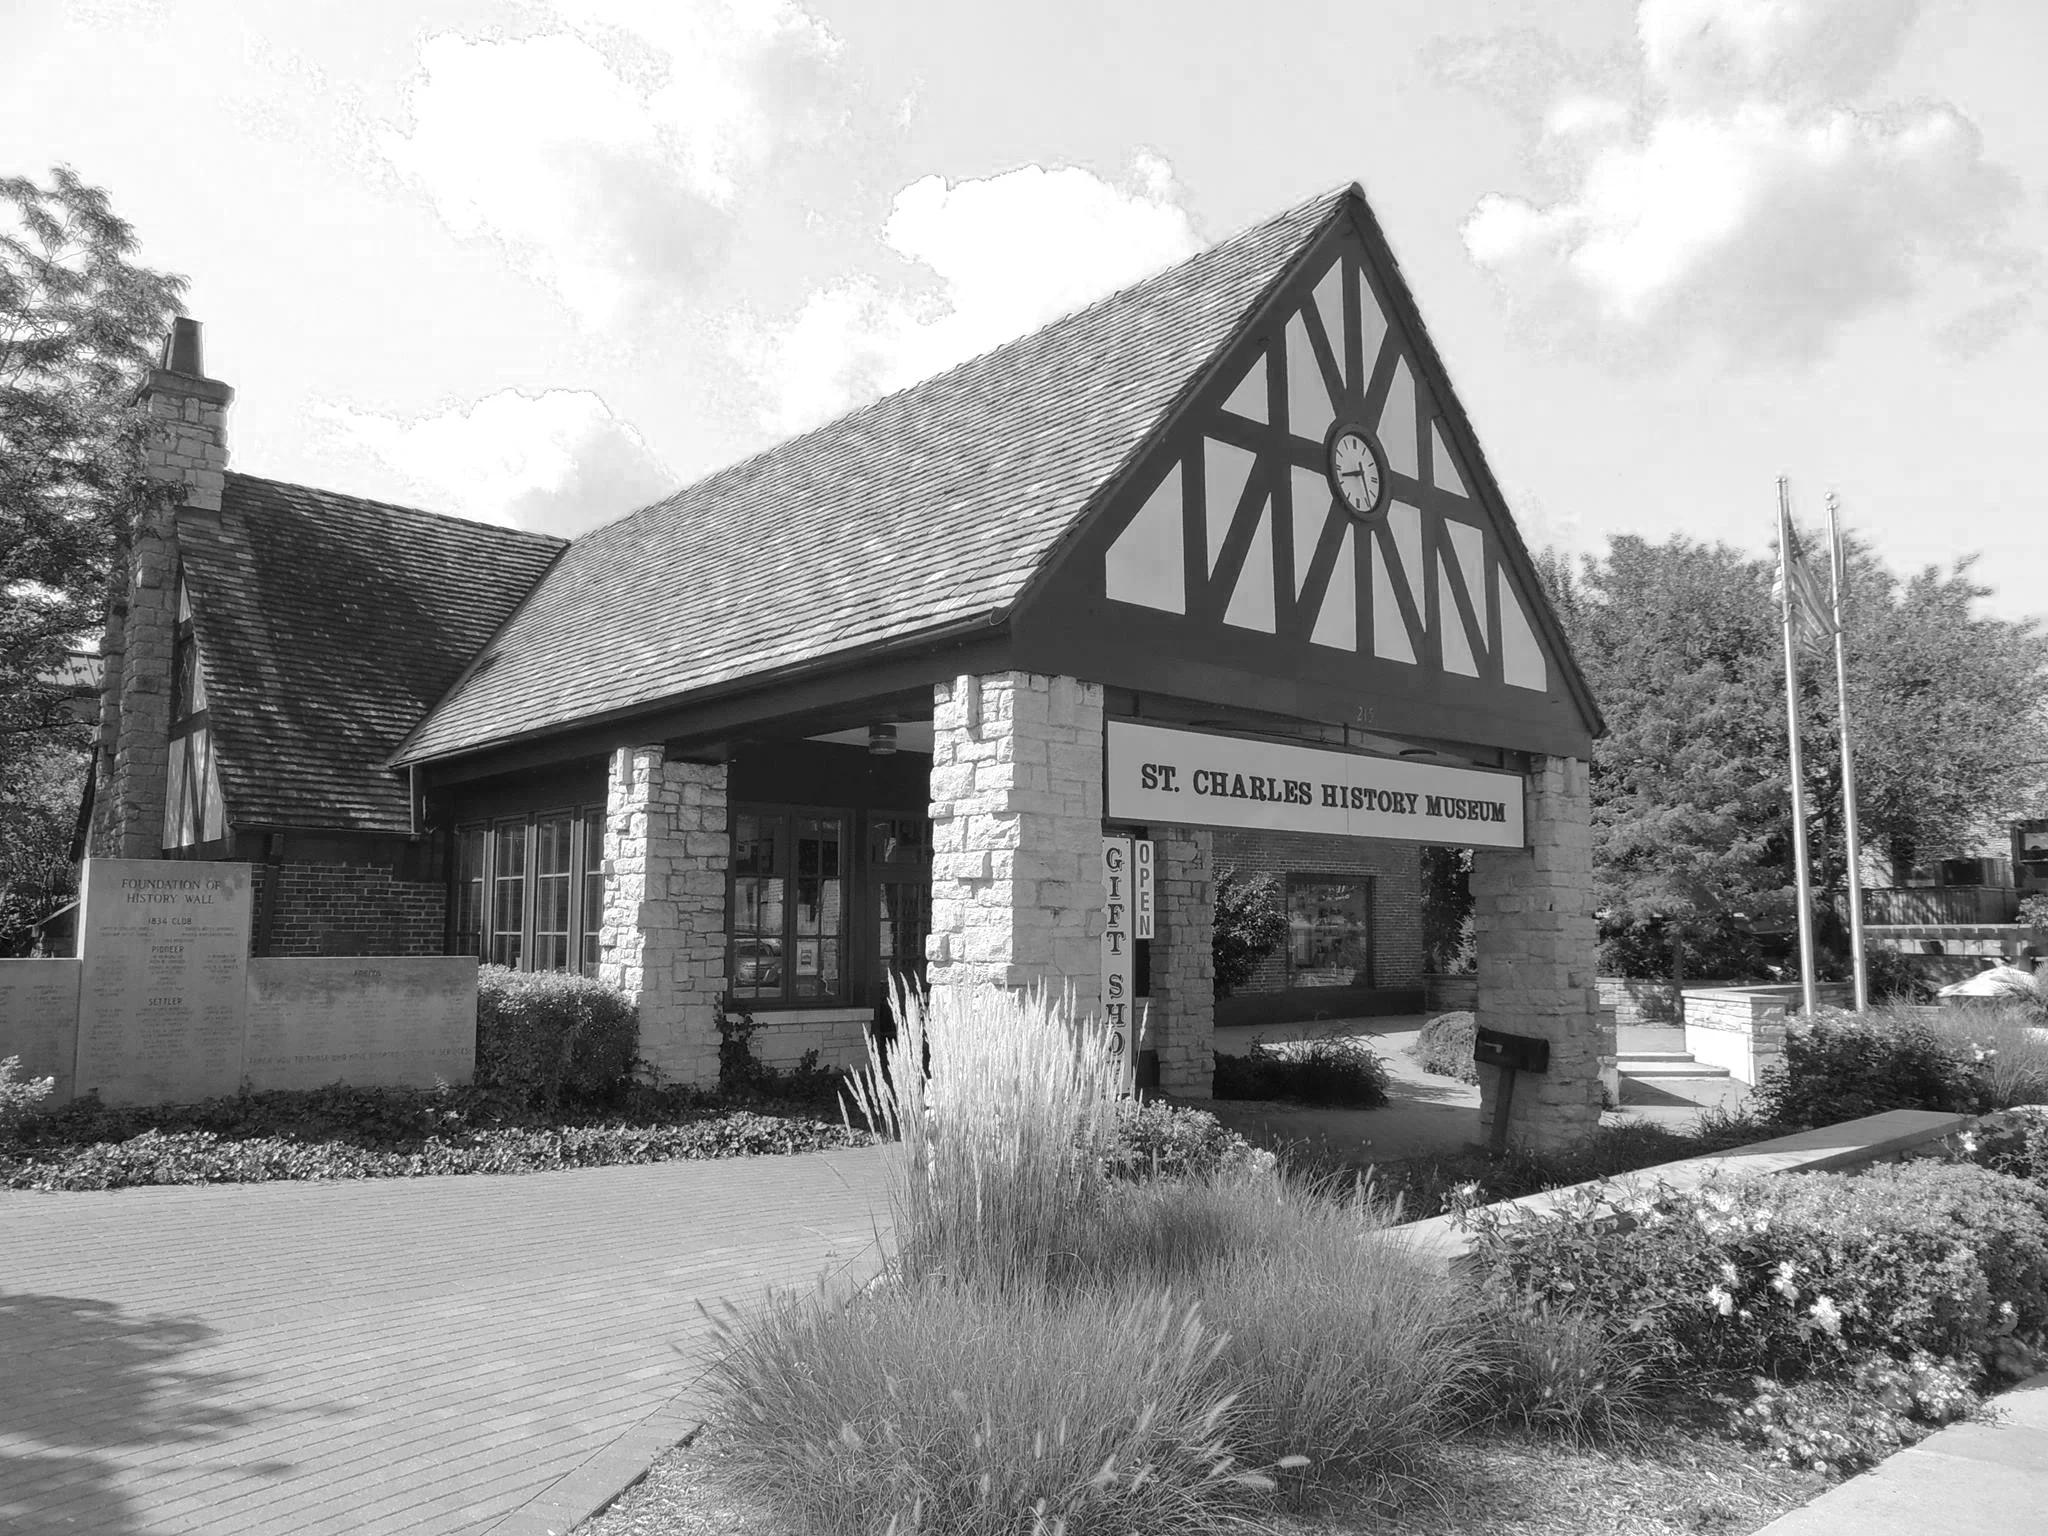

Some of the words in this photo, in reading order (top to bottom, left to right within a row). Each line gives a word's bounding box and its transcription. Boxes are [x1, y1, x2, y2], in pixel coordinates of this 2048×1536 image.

[1141, 763, 1180, 793] ST.
[1193, 769, 1313, 805] CHARLES
[1321, 784, 1419, 815] HISTORY
[1425, 795, 1507, 823] MUSEUM
[121, 878, 201, 890] FOUNDATION
[206, 880, 221, 890] OF
[1139, 843, 1151, 936] OPEN
[126, 893, 178, 904] HISTORY
[184, 894, 214, 905] WALL
[1106, 847, 1126, 955] GIFT
[171, 917, 192, 925] CLUB
[148, 997, 183, 1006] SETTLER
